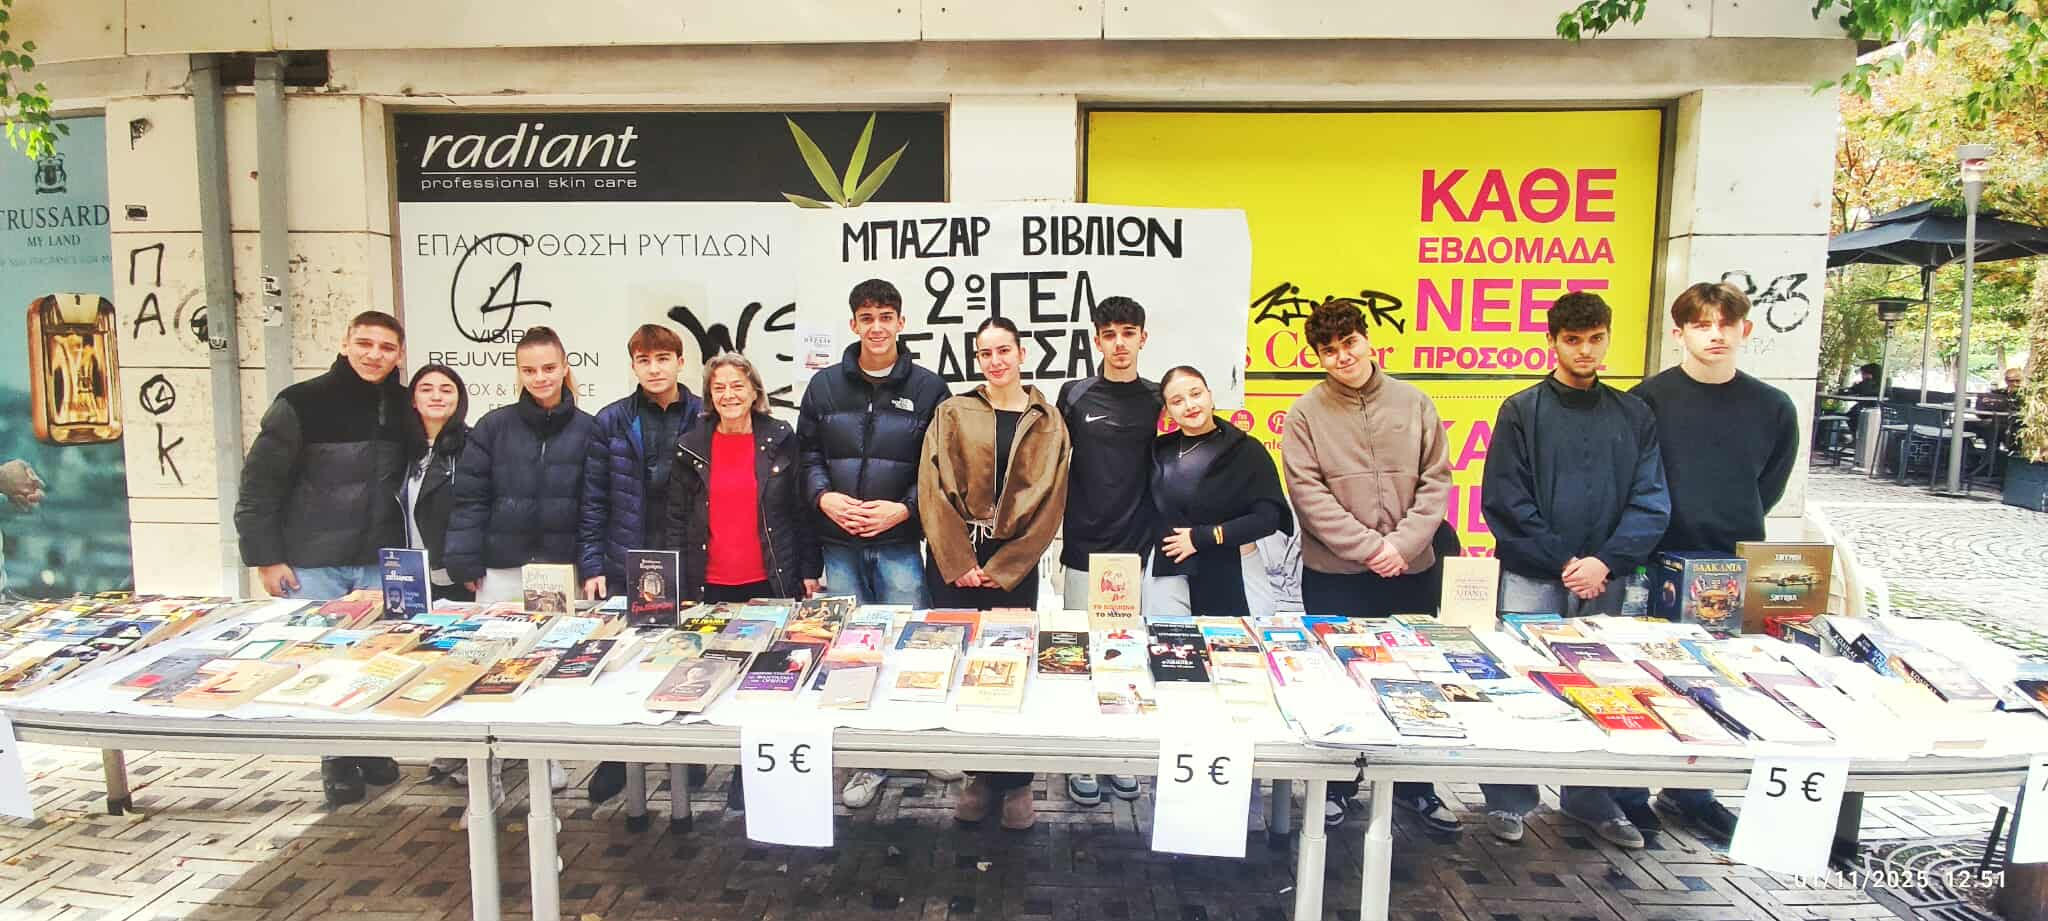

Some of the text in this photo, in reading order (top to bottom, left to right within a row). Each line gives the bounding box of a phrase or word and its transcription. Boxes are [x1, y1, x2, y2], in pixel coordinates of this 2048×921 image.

[421, 123, 638, 169] radiant
[421, 176, 638, 191] professional skin care
[1420, 168, 1617, 224] ΚΑΘΕ
[48, 234, 81, 247] LAND
[417, 234, 771, 257] ΕΠΑΝΟΡΘΩΣΗ ΡΥΤΙΔΩΝ
[842, 216, 991, 262] ΜΠΑΖΑΡ
[1418, 237, 1616, 264] ΕΒΔΟΜΑΔΑ
[472, 329, 525, 344] VISIB
[756, 743, 812, 773] 5 €
[1173, 753, 1232, 785] 5 €
[1766, 767, 1825, 802] 5 €
